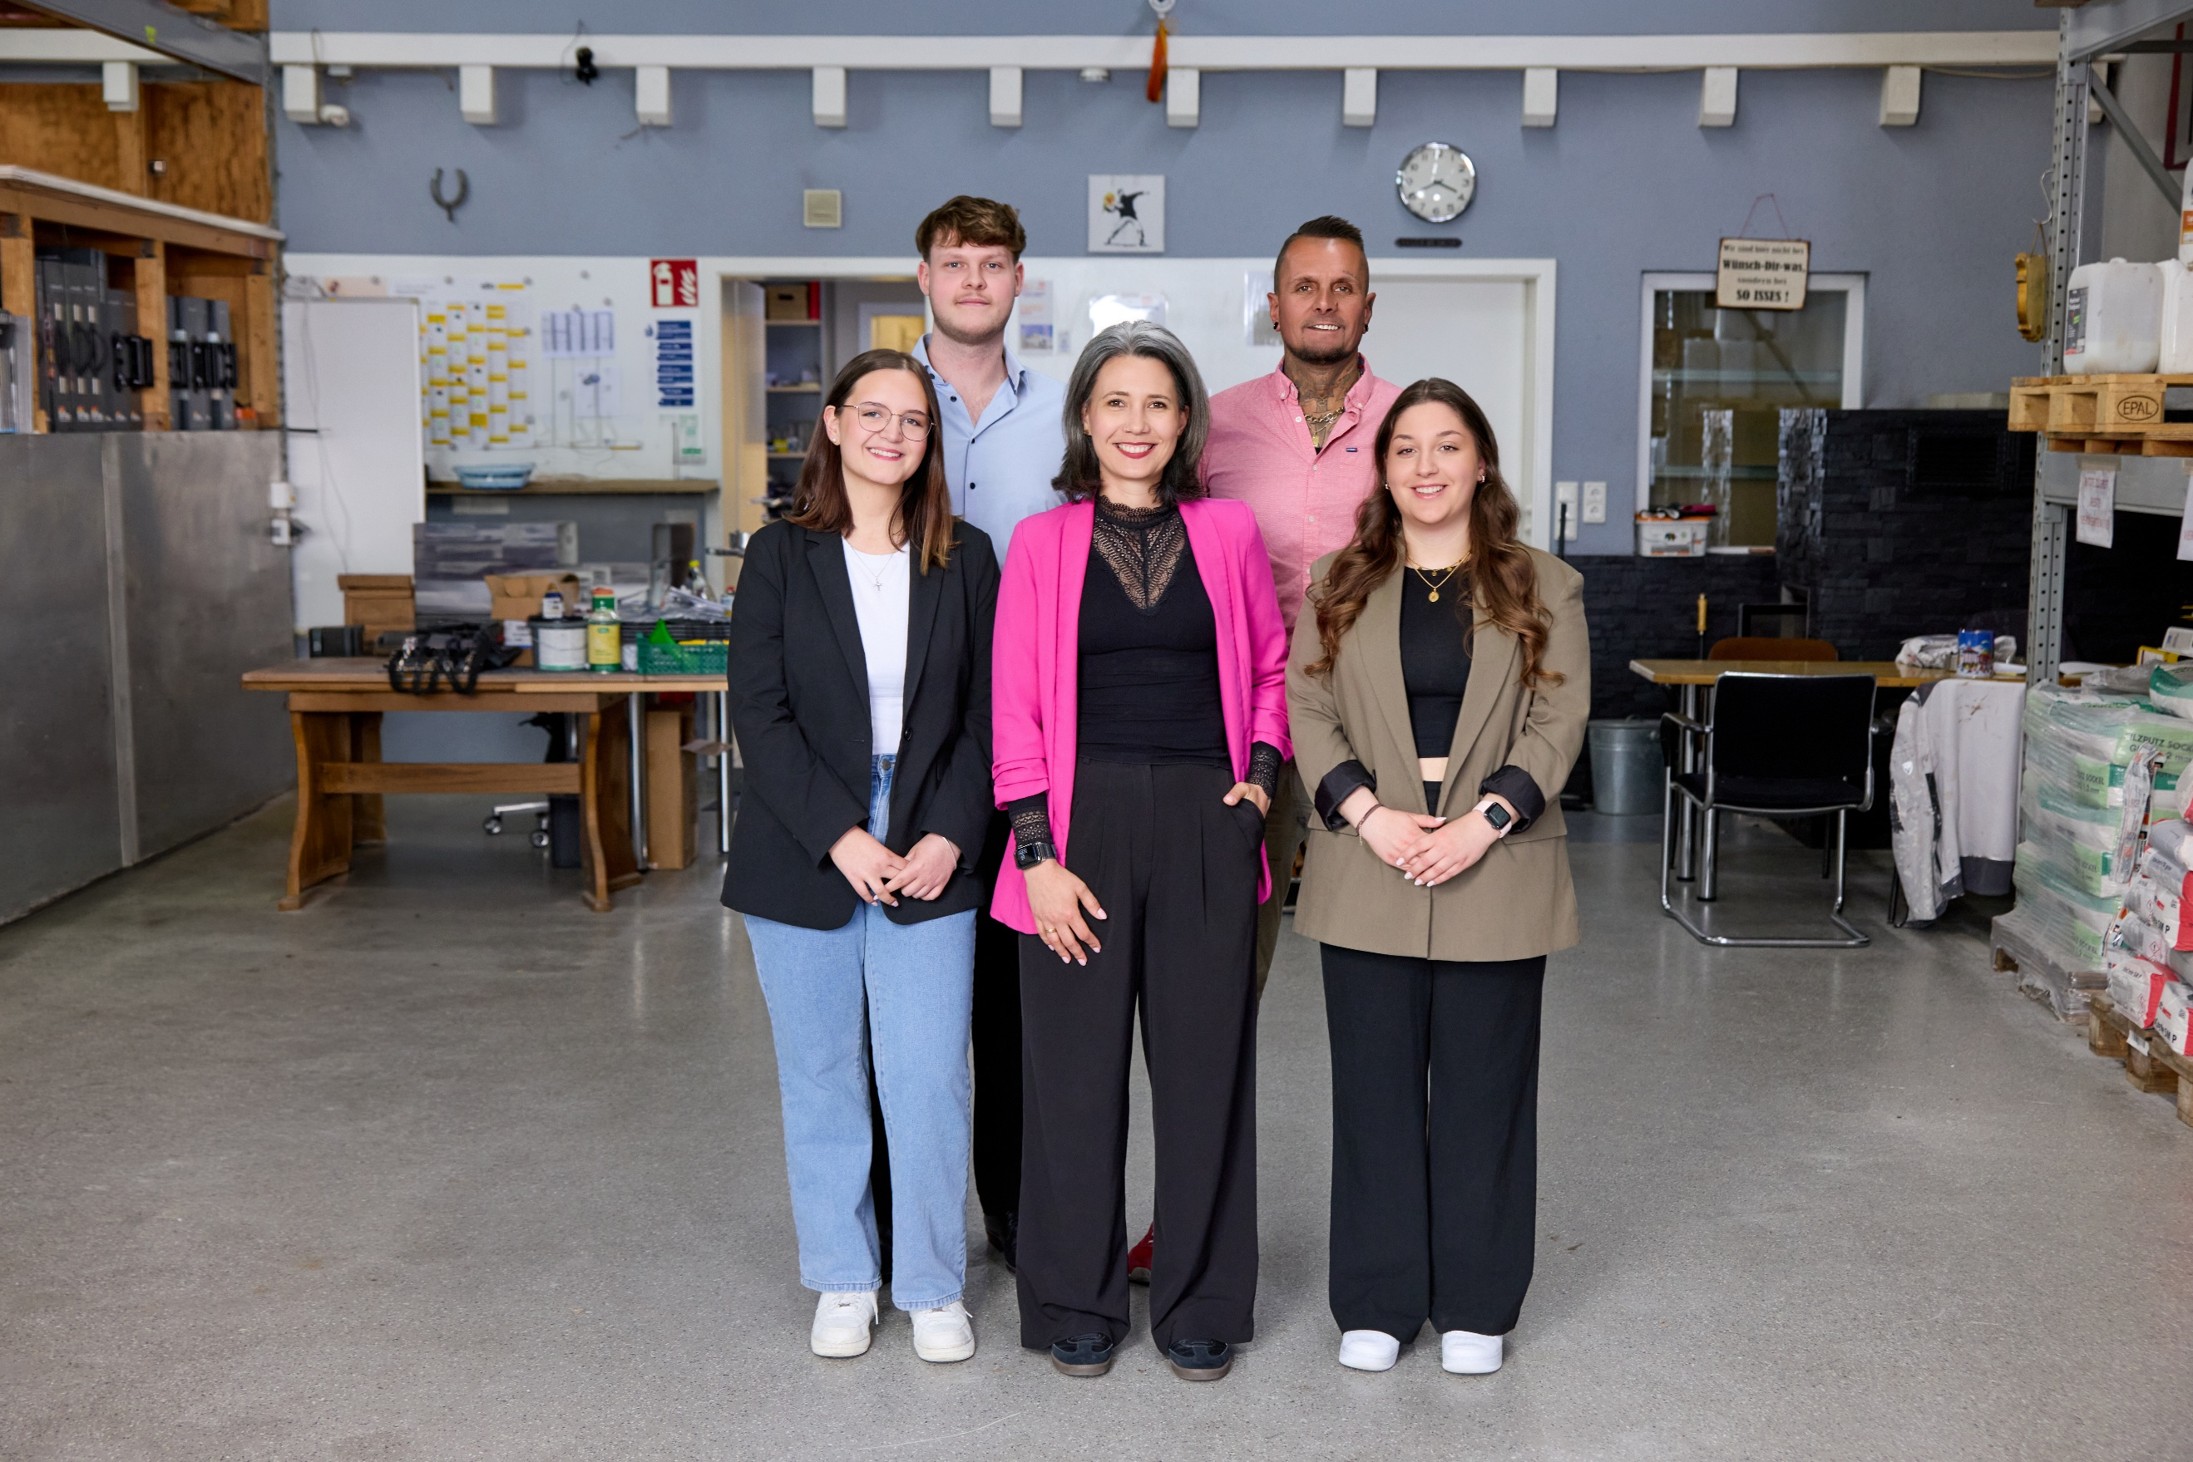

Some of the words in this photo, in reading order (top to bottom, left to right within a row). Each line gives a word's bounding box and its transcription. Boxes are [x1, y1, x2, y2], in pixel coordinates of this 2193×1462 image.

[1736, 289, 1750, 301] SO
[1754, 290, 1782, 302] ISSES
[2123, 401, 2152, 415] EPAL
